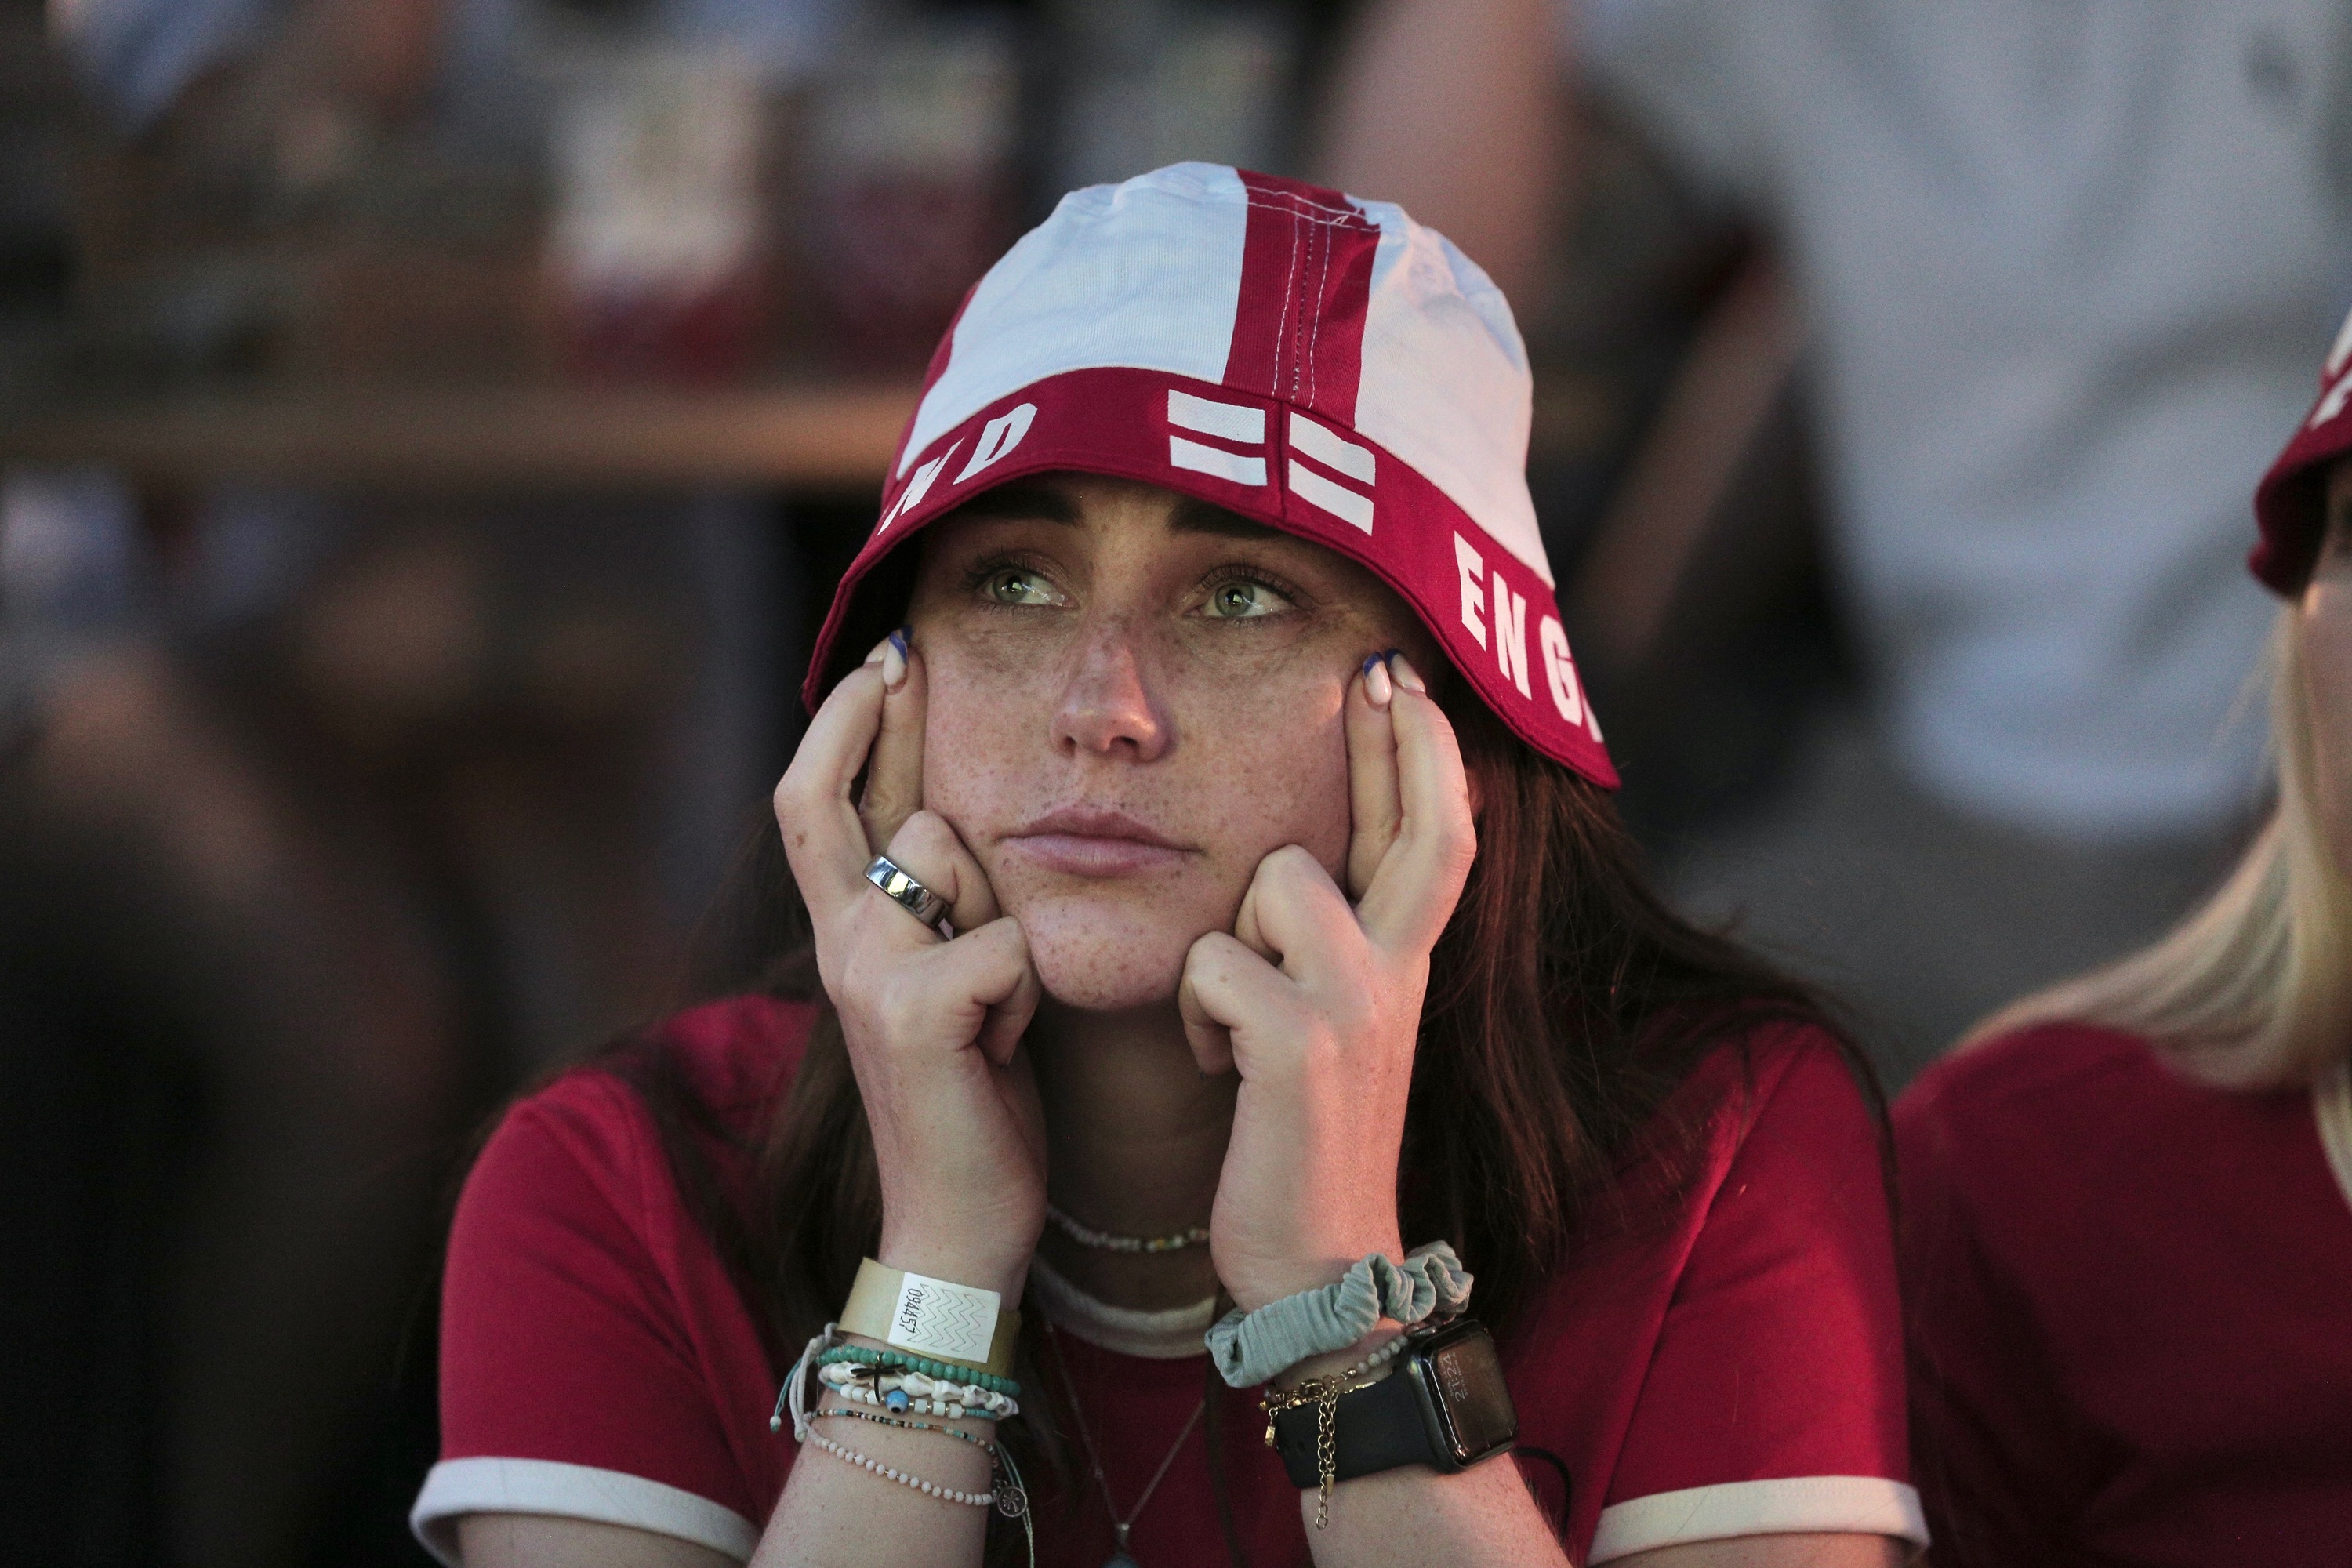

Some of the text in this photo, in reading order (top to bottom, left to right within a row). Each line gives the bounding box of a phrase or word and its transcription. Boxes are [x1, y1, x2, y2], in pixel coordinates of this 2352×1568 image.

[877, 402, 1038, 536] ND
[899, 1287, 922, 1334] 094457
[1443, 1353, 1465, 1402] 21:24
